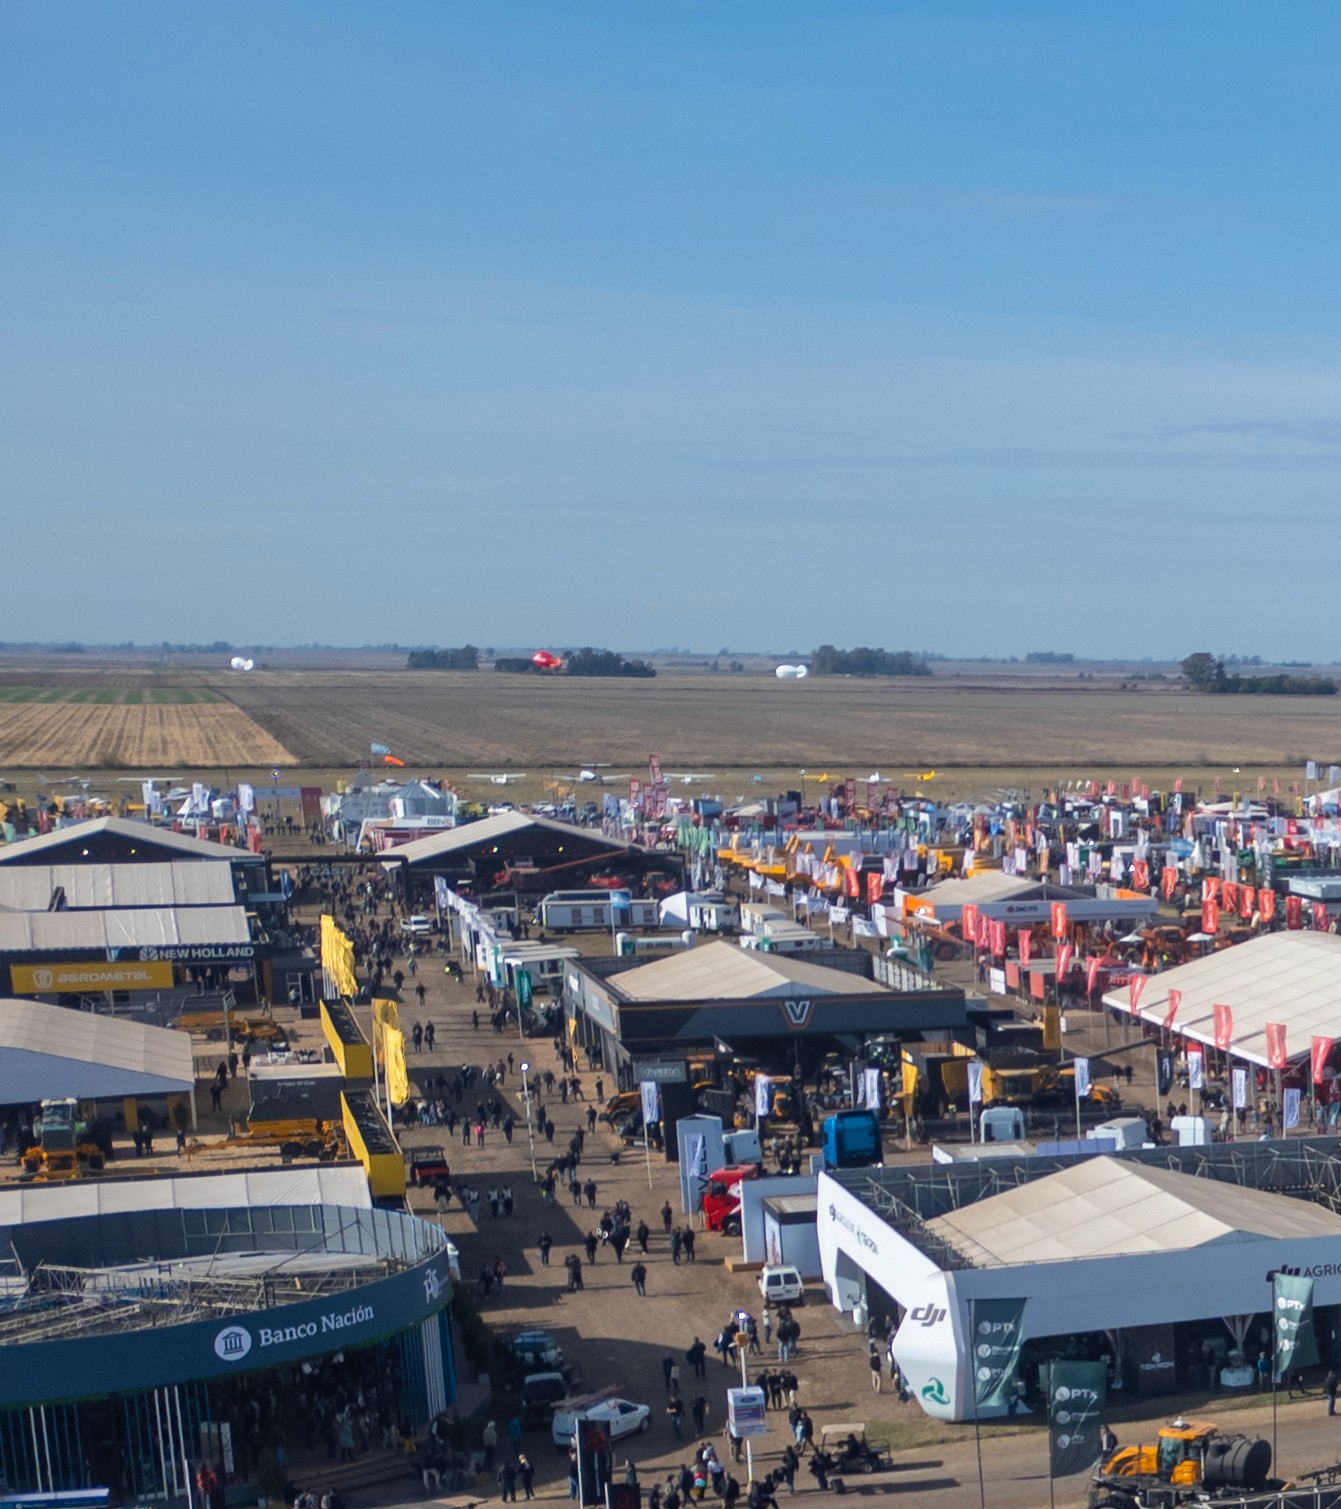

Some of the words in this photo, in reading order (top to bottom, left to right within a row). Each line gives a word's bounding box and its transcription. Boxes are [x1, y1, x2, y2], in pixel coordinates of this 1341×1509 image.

[159, 948, 190, 959] NEW
[191, 947, 254, 958] HOLLAND
[259, 1321, 317, 1347] Banco
[320, 1303, 374, 1336] Nación
[1140, 1361, 1175, 1371] TEKRON
[1071, 1388, 1098, 1399] PTx
